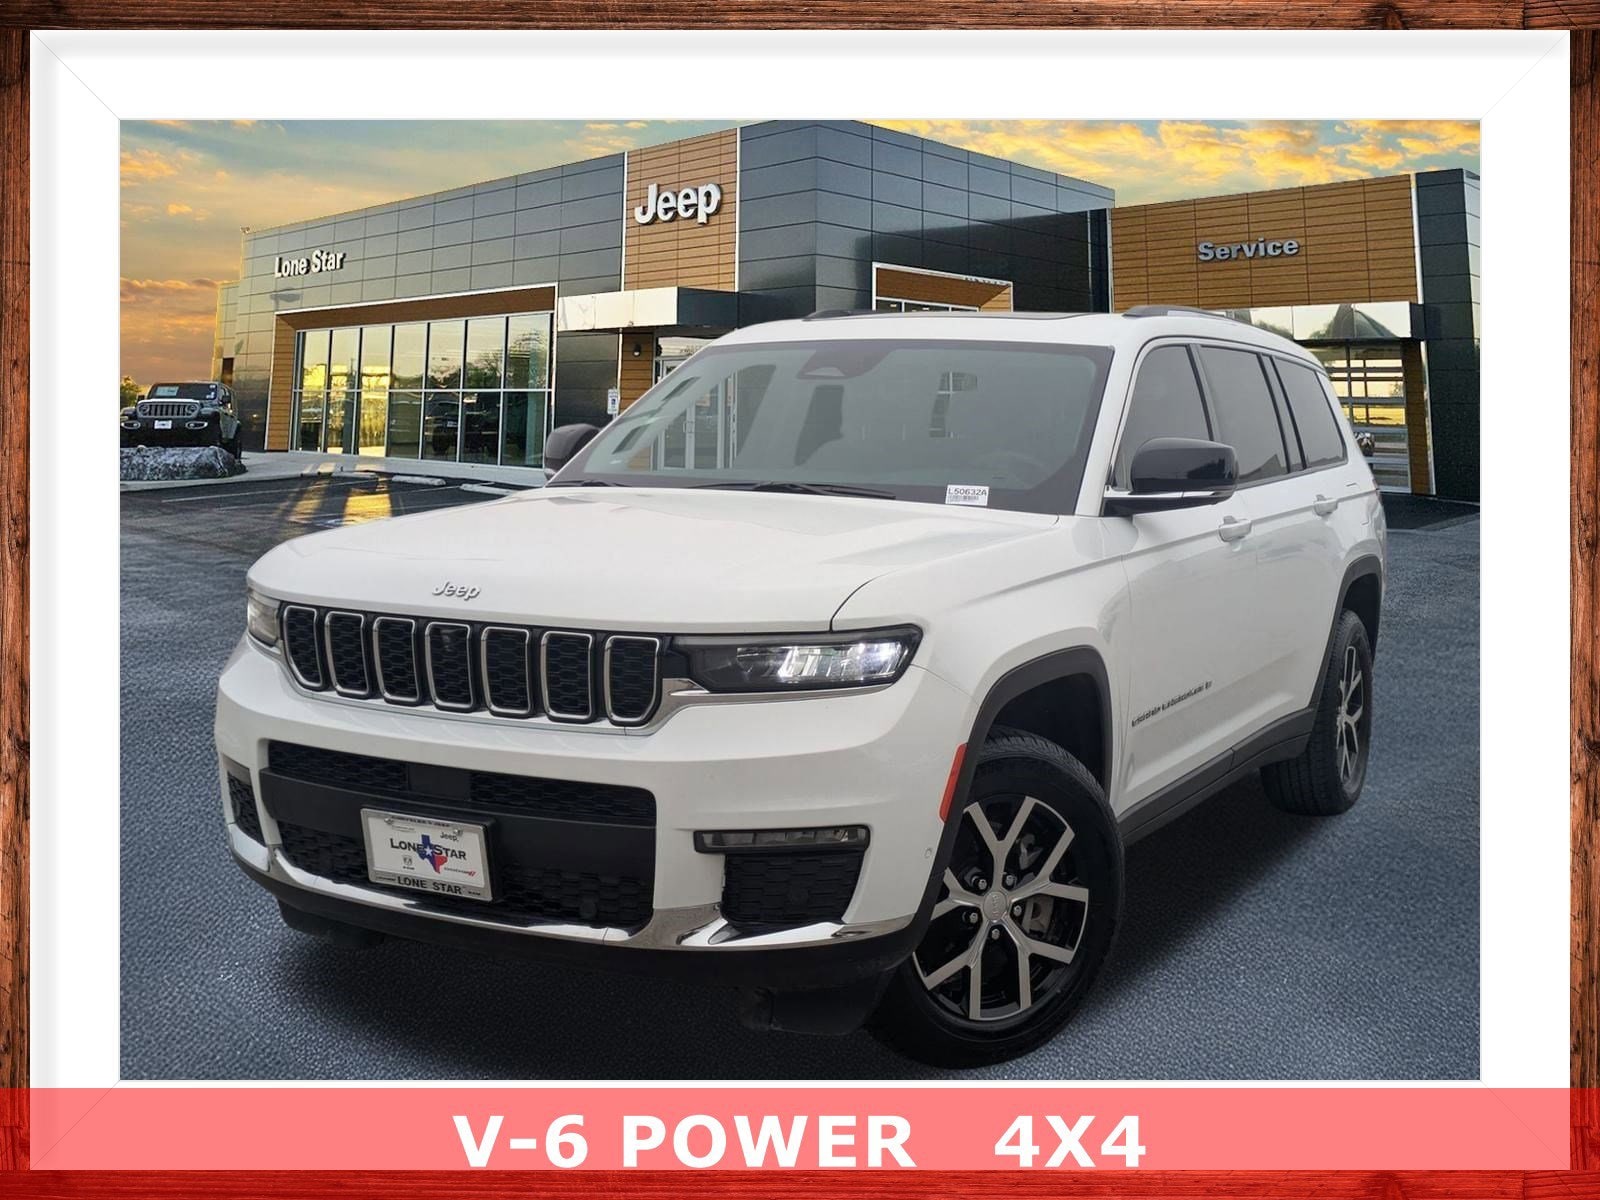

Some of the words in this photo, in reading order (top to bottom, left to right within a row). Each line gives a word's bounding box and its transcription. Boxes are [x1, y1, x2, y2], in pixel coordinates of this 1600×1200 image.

[634, 183, 722, 224] Jeep
[1198, 237, 1299, 261] Service
[275, 256, 310, 277] Lone
[311, 249, 345, 273] Star
[432, 580, 481, 601] Jeep
[390, 838, 424, 855] LONE
[434, 844, 467, 860] STAR
[398, 876, 428, 889] LONE
[433, 881, 462, 895] STAR
